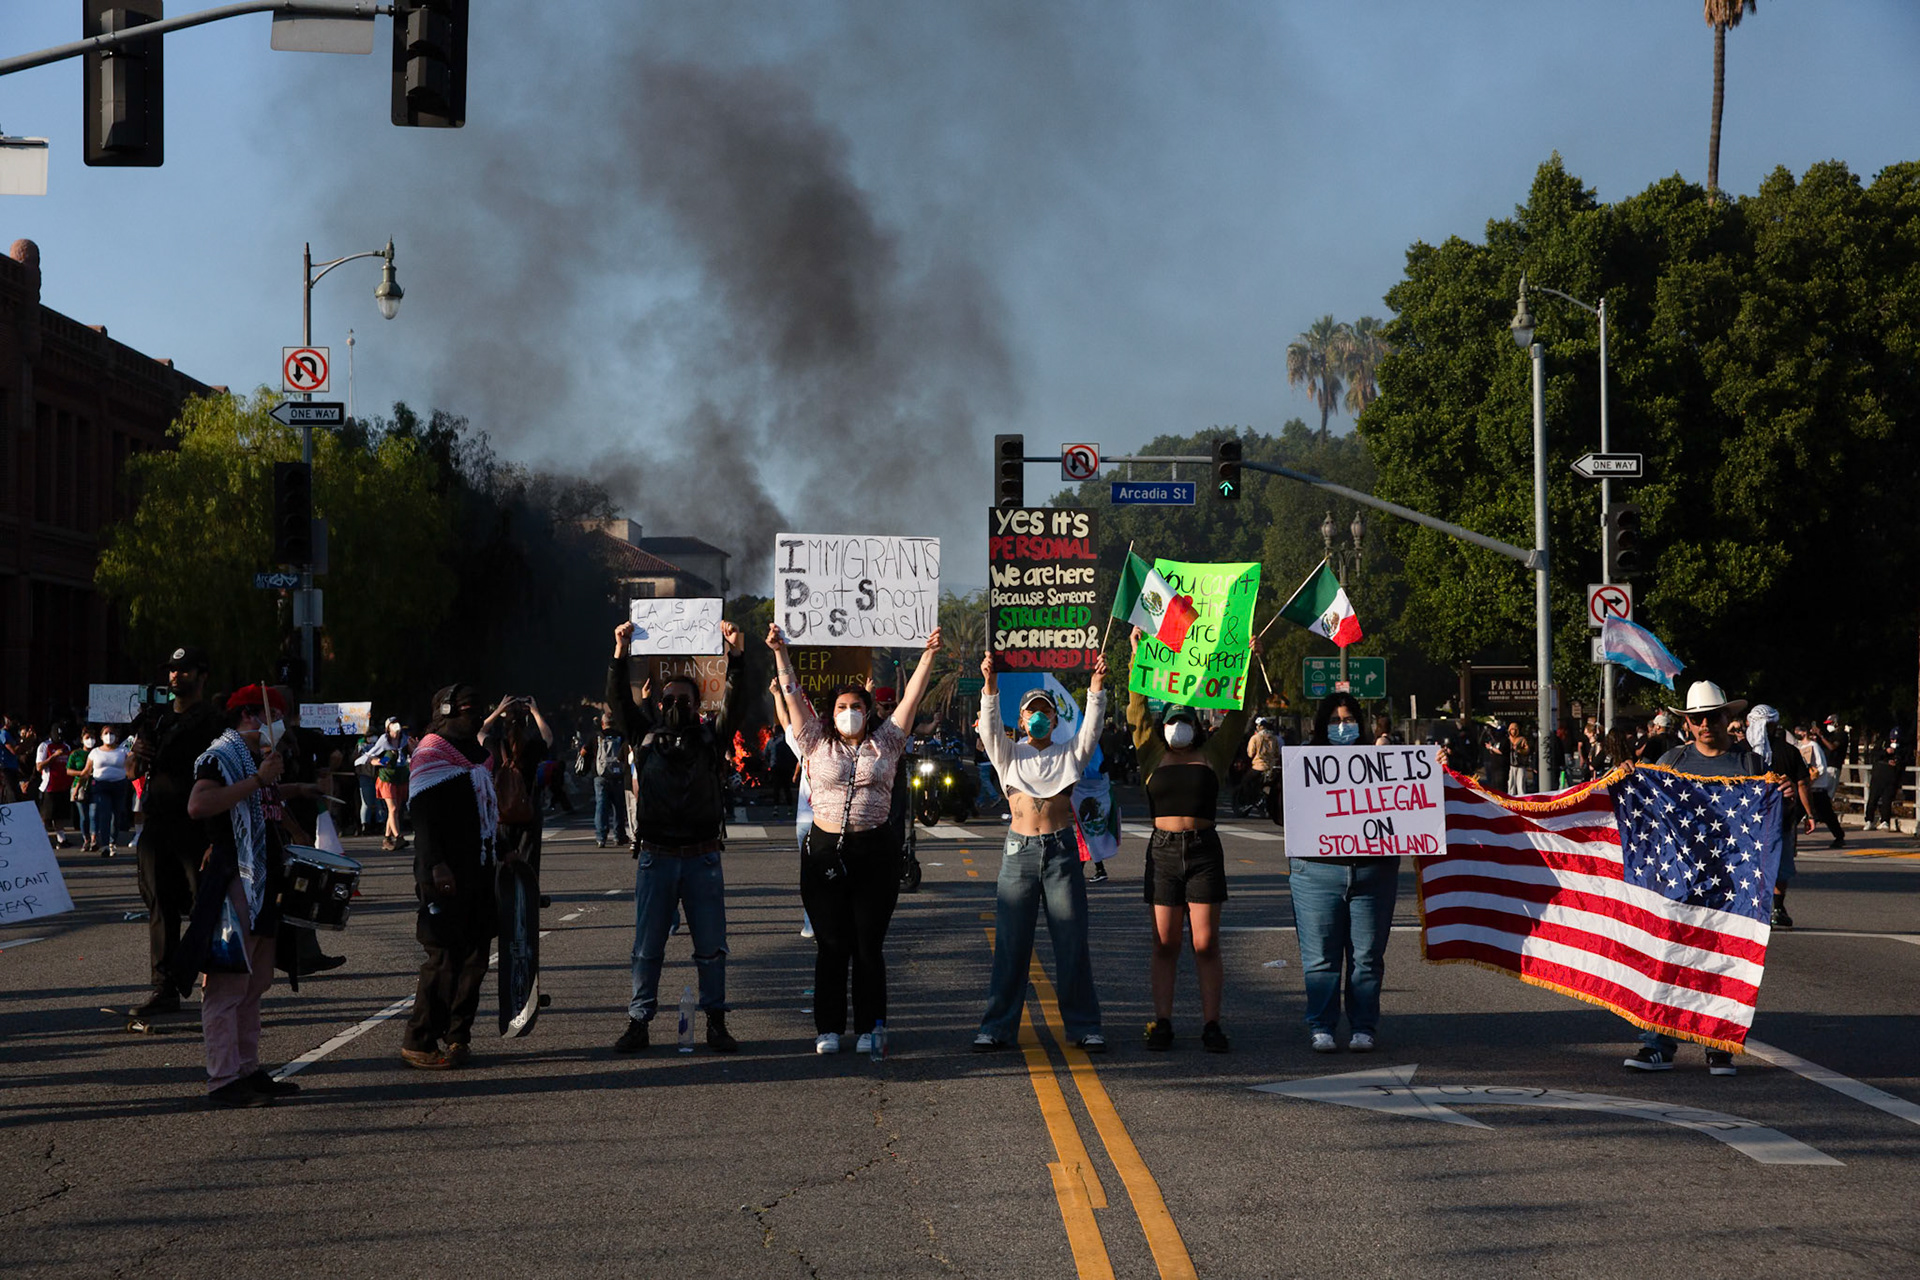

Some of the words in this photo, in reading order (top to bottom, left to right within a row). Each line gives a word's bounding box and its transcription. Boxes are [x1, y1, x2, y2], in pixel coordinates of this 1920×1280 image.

[291, 409, 311, 418] ONE
[315, 409, 335, 418] WAY
[1593, 461, 1611, 469] ONE
[1615, 461, 1633, 469] WAY
[1119, 487, 1167, 499] Arcadia
[1173, 487, 1187, 499] St
[779, 538, 940, 580] IMMIGRANTS
[990, 535, 1097, 560] PERSONAL
[991, 563, 1020, 588] We
[1023, 566, 1054, 586] are
[1055, 563, 1095, 585] here
[785, 578, 853, 609] Don't
[856, 578, 929, 612] Shoot
[991, 588, 1045, 608] Because
[1047, 587, 1096, 606] Someone
[637, 603, 658, 619] LA
[671, 601, 685, 614] IS
[700, 602, 709, 617] A
[998, 605, 1091, 630] STRUGGLED
[1197, 598, 1230, 617] the
[633, 619, 719, 635] SANCTUARY
[1223, 615, 1239, 646] &
[995, 649, 1082, 669] NDURED
[1188, 647, 1247, 672] Support
[1137, 664, 1180, 694] THE
[1183, 674, 1244, 700] PEOPLE
[1491, 680, 1537, 690] PARKING
[1303, 755, 1340, 787] NO
[1348, 751, 1397, 784] ONE
[1401, 749, 1431, 781] IS
[1326, 783, 1436, 817] ILLEGAL
[1363, 816, 1394, 840] ON
[1319, 834, 1392, 855] STOLEN
[1394, 833, 1438, 855] LAND
[15, 872, 50, 889] CANT
